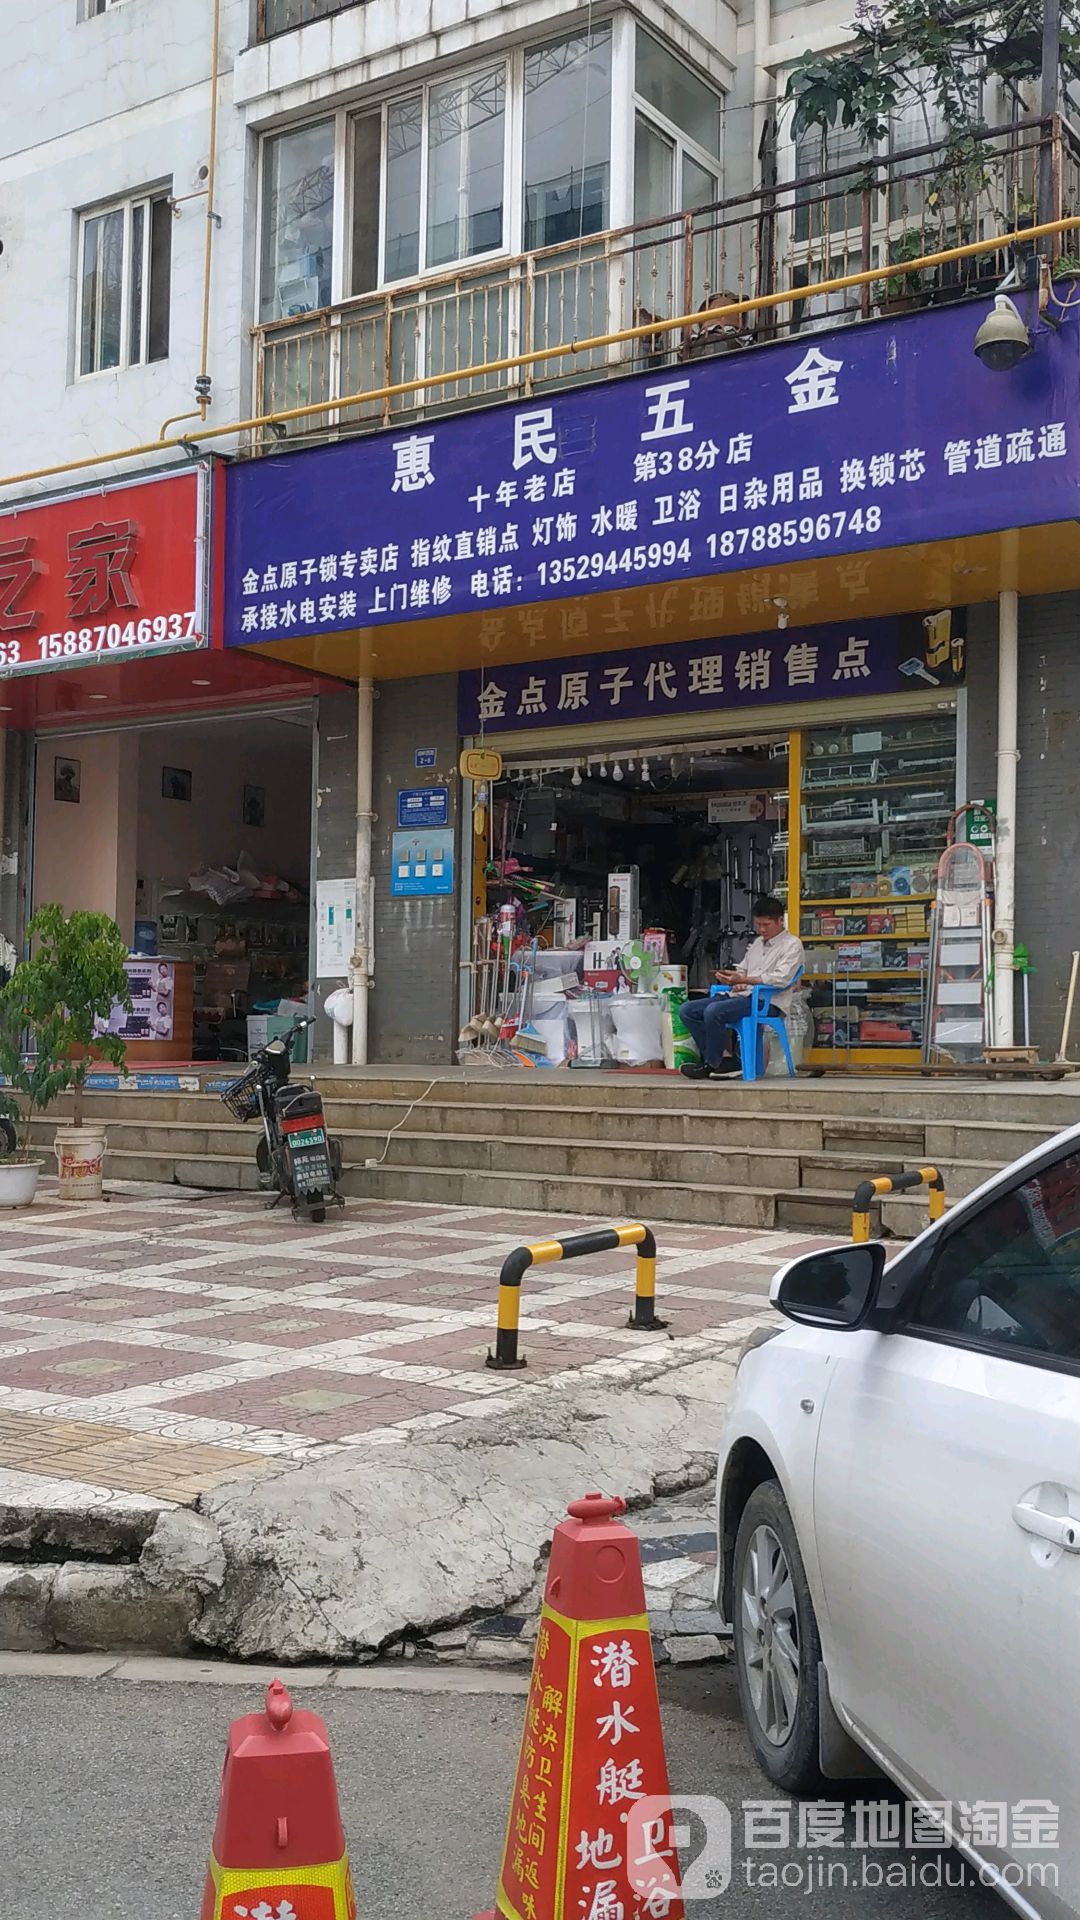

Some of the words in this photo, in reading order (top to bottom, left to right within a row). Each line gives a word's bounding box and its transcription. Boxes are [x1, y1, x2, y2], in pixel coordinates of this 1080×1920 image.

[391, 347, 844, 493] 惠民五金
[633, 432, 754, 483] 第38分店
[242, 543, 399, 596] 金点原子锁专卖店
[410, 523, 519, 569] 指纹直销点
[532, 512, 577, 547] 灯饰
[591, 499, 638, 537] 水暖
[652, 488, 702, 526] 卫浴
[719, 466, 823, 513] 日杂用品
[840, 447, 926, 493] 换锁芯
[944, 421, 1067, 476] 管道疏通
[468, 468, 576, 514] 十年老店
[241, 591, 357, 632] 承接水电安装
[368, 575, 452, 615] 上门维修
[538, 539, 691, 587] 13529445994
[706, 505, 882, 559] 18788596748
[38, 611, 197, 660] 15887046937
[477, 636, 872, 720] 金点原子代理销售点
[590, 1641, 647, 1806] 潜水艇
[521, 1684, 563, 1920] 解决卫生间返味
[632, 1817, 679, 1918] 卫浴
